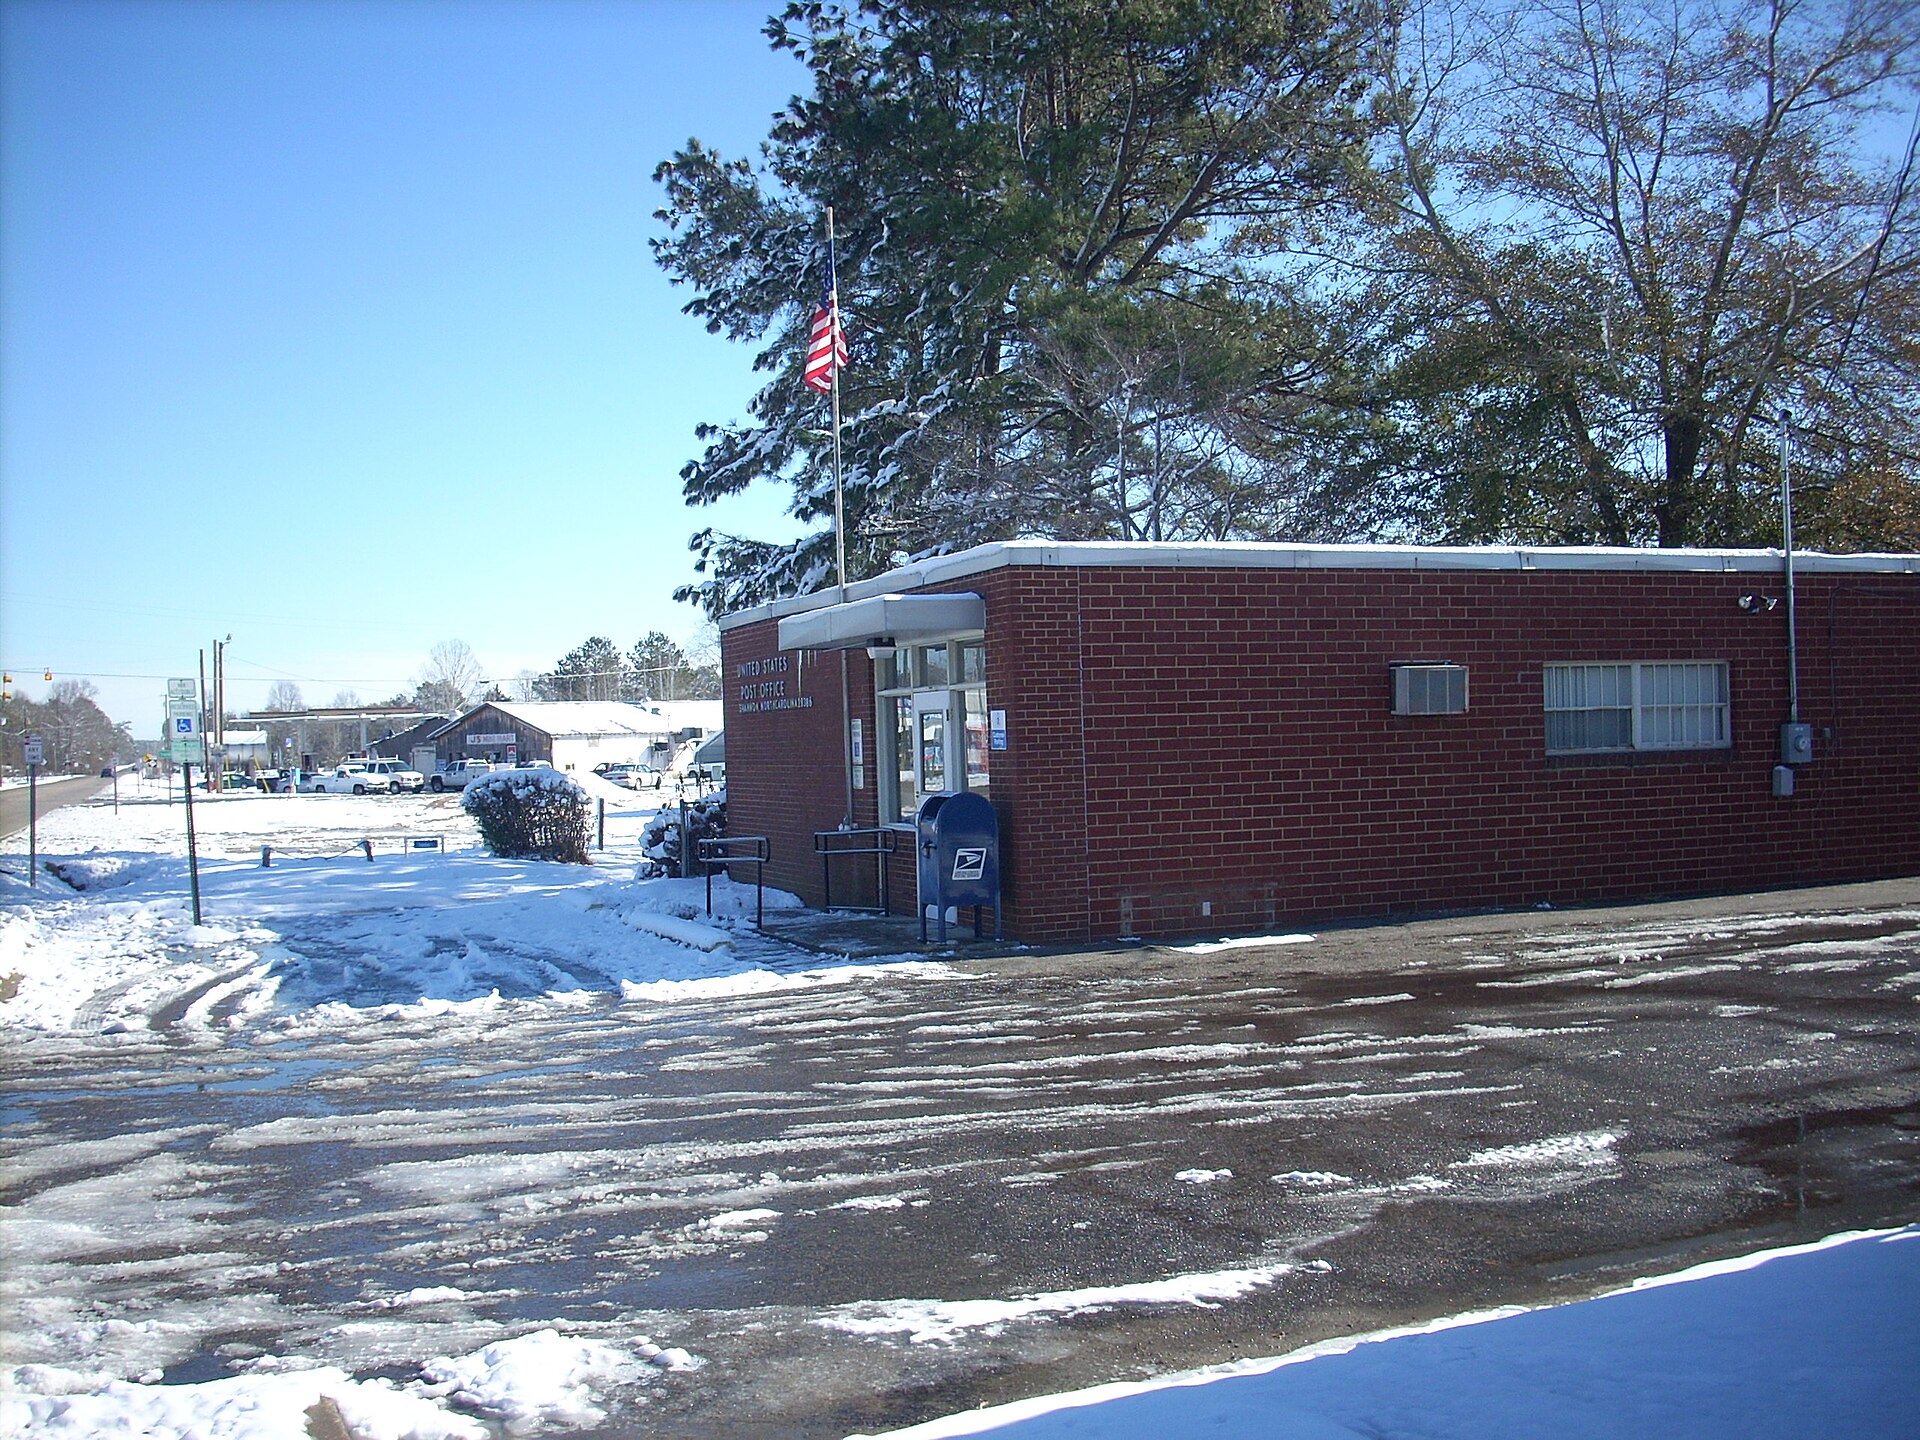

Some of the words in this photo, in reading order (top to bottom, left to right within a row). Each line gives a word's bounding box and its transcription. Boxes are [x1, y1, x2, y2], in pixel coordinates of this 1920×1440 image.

[737, 661, 760, 677] UNITED
[763, 656, 788, 674] STATES
[741, 684, 757, 700] POST
[760, 681, 785, 698] OFFICE
